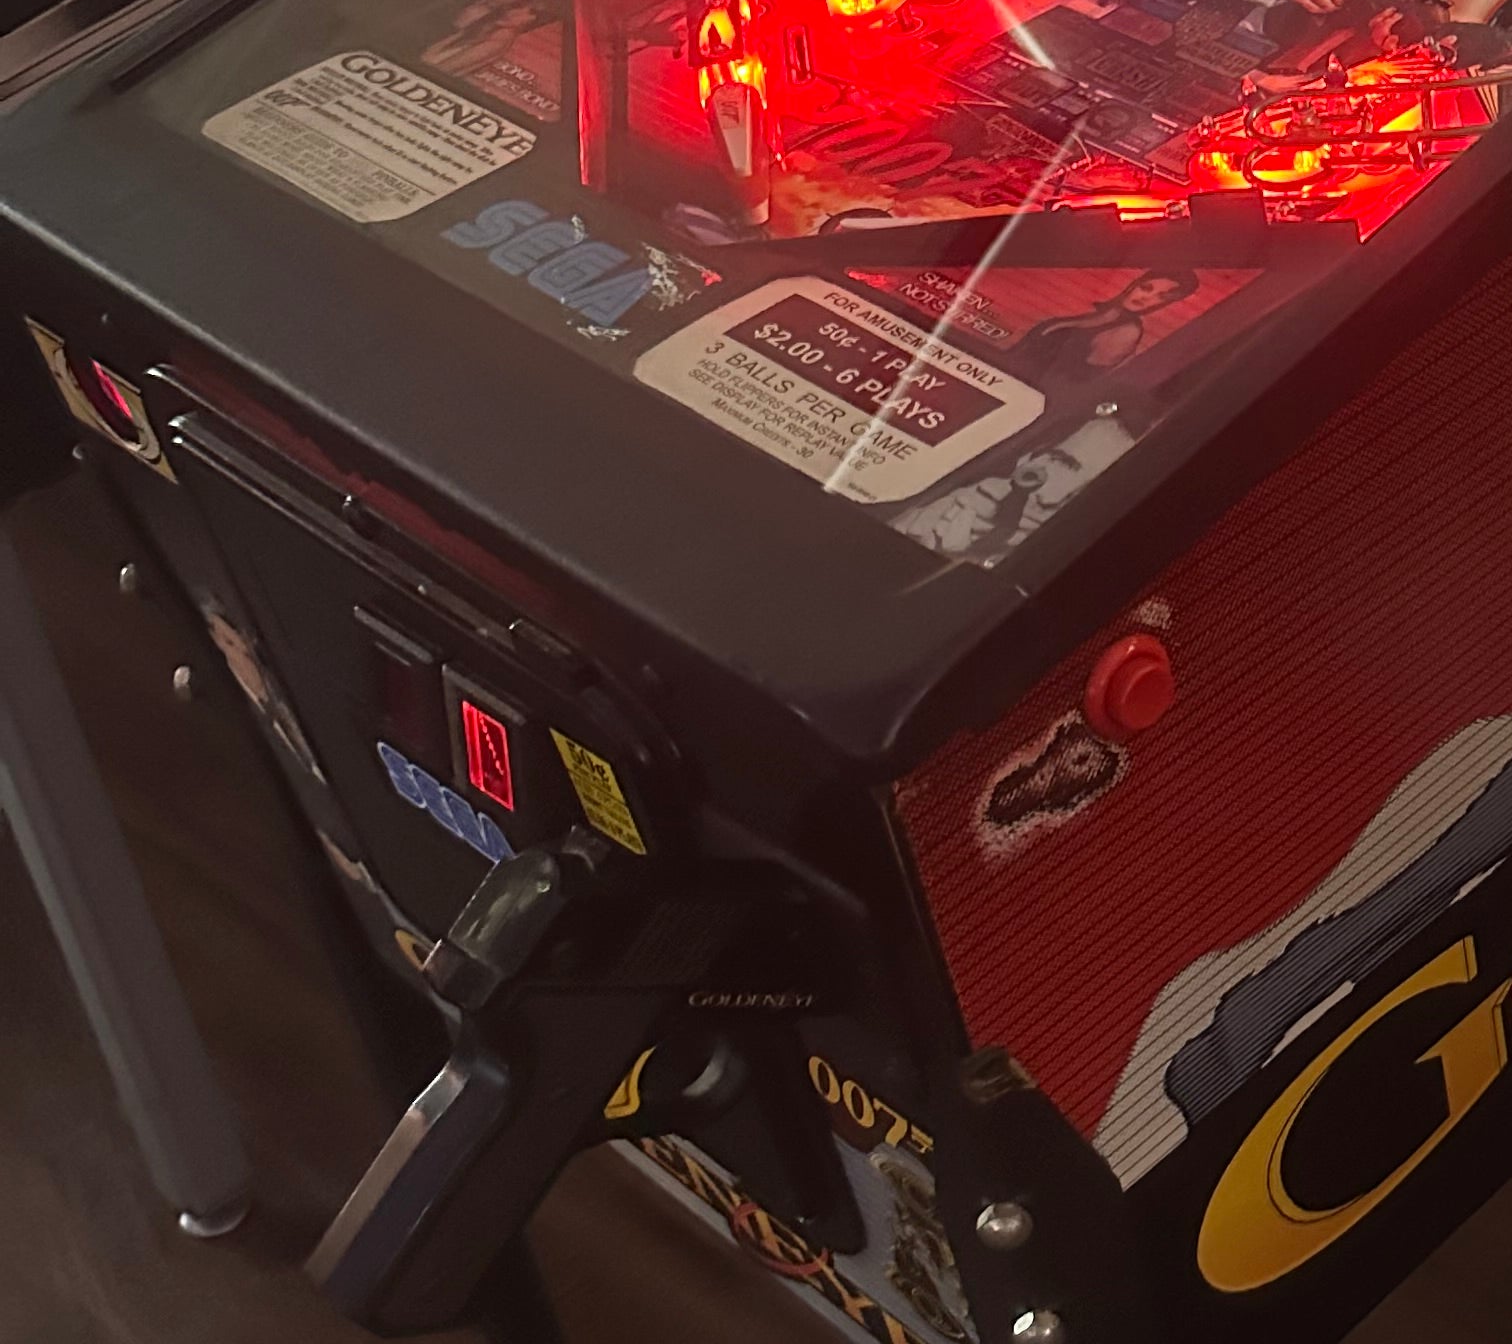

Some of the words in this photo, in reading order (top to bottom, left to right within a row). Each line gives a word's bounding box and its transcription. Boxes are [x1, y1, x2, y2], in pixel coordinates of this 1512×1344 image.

[335, 51, 539, 156] GOLDENEYE
[440, 200, 655, 328] SEGA
[694, 358, 733, 380] HOLD
[779, 404, 813, 423] FOR
[748, 321, 830, 366] $2.00
[830, 367, 862, 385] 6
[852, 378, 950, 431] PLAYS
[814, 321, 863, 350] 50¢
[881, 357, 948, 393] PLAY
[822, 291, 862, 313] FOR
[854, 308, 961, 365] AMUSEMENT
[952, 360, 1004, 388] ONLY
[685, 367, 715, 385] SEE
[756, 407, 788, 426] FOR
[825, 446, 869, 472] VAUE
[701, 340, 727, 355] 3
[723, 352, 797, 395] BALLS
[794, 392, 848, 423] PER
[845, 420, 918, 460] GAME
[808, 1056, 935, 1152] 007
